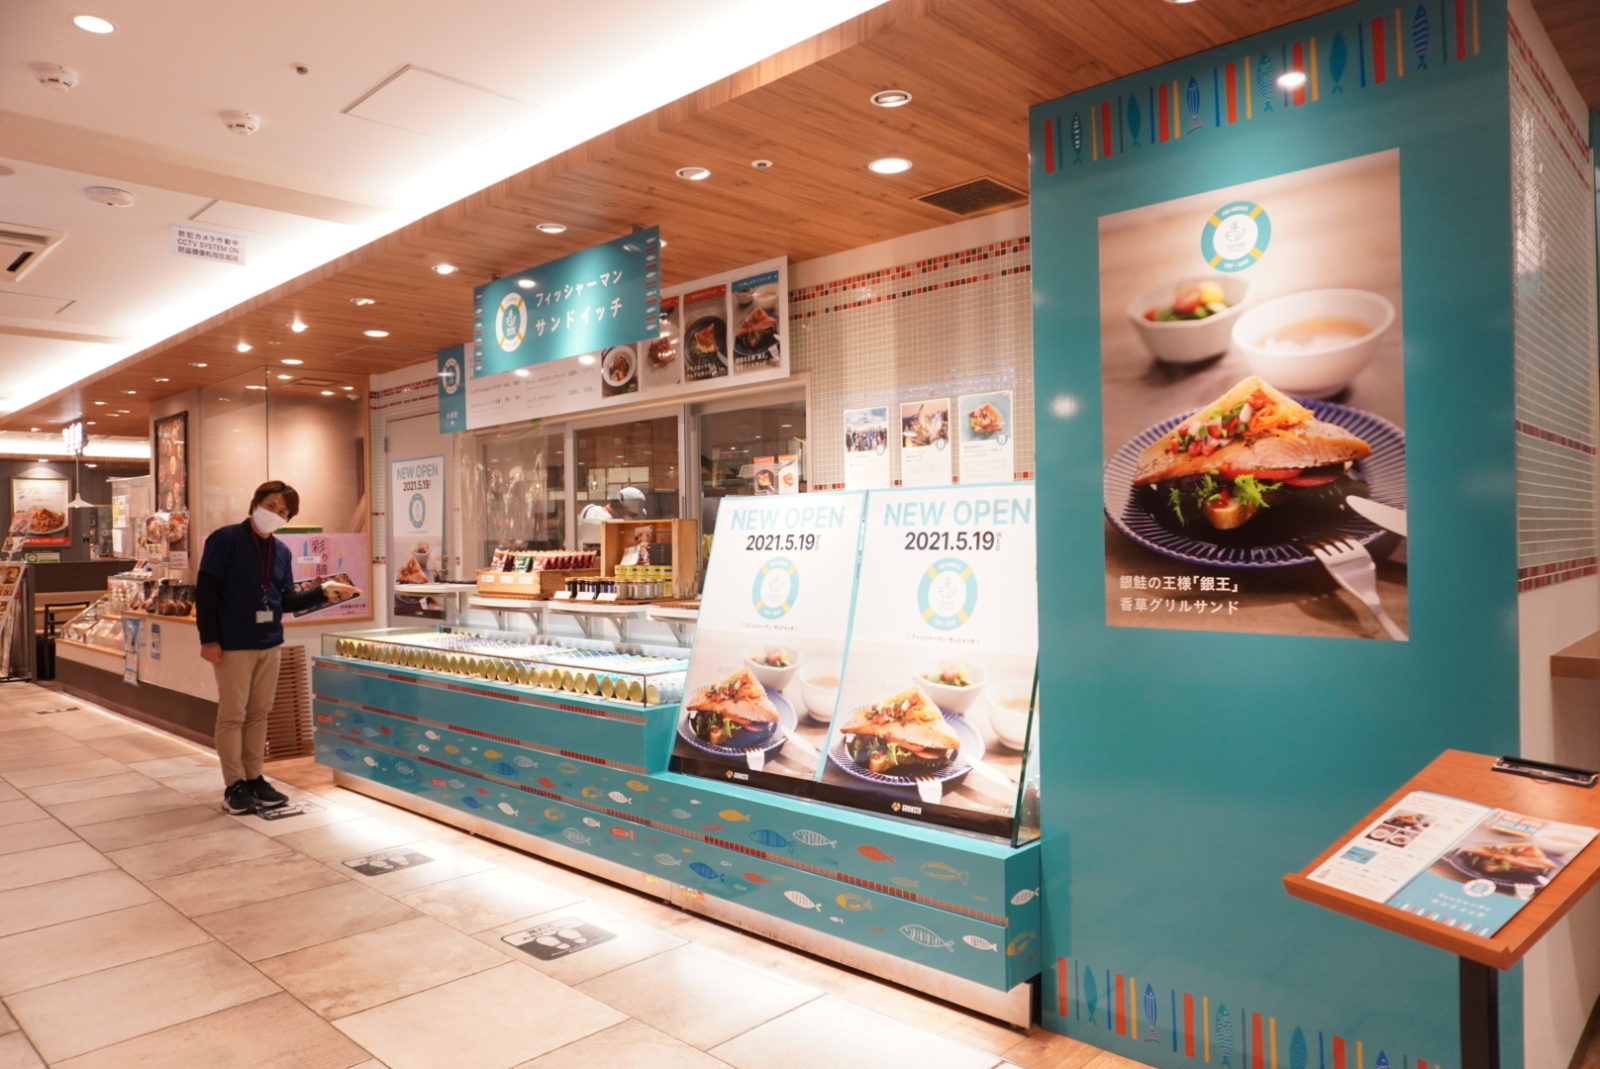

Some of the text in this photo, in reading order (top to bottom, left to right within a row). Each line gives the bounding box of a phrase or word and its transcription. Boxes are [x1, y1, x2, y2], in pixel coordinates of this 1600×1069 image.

[178, 230, 238, 245] 防犯カメラ作動中
[178, 238, 197, 247] CCTV
[200, 242, 227, 251] SYSTEM
[536, 270, 622, 307] フィッシャーマン
[536, 297, 622, 336] サンドイッチ
[397, 463, 438, 480] NEW OPEN
[403, 480, 430, 491] 2021.5.19
[730, 505, 846, 531] NEW OPEN
[884, 498, 1032, 526] NEW OPEN
[745, 533, 815, 552] 2021.5.19
[904, 531, 995, 551] 2021.5.19
[1119, 575, 1239, 593] 銀鮭の王様「銀王」
[1119, 597, 1240, 615] 香草グリルサンド
